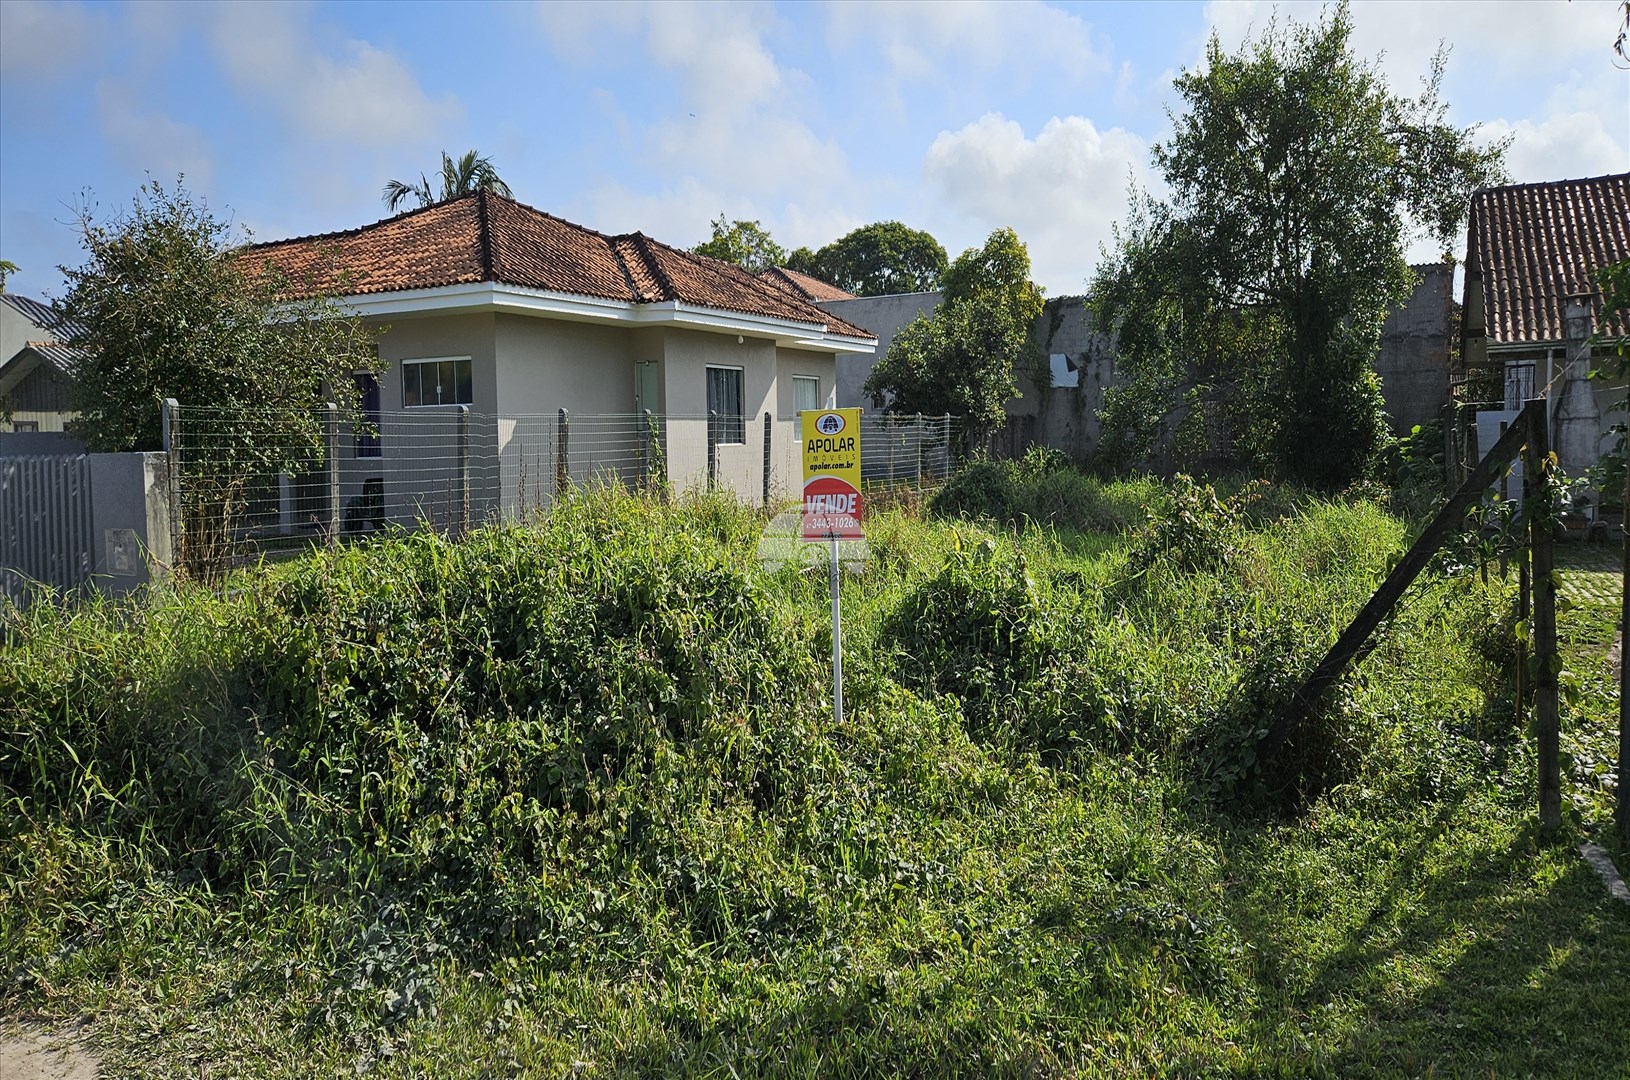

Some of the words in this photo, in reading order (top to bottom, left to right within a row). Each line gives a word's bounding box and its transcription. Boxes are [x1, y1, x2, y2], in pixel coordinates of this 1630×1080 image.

[807, 437, 855, 453] APOLAR
[807, 453, 855, 462] IMÓVEIS
[809, 461, 854, 472] apolar.com.br
[806, 493, 857, 514] VENDE
[812, 517, 854, 529] 3443-1026
